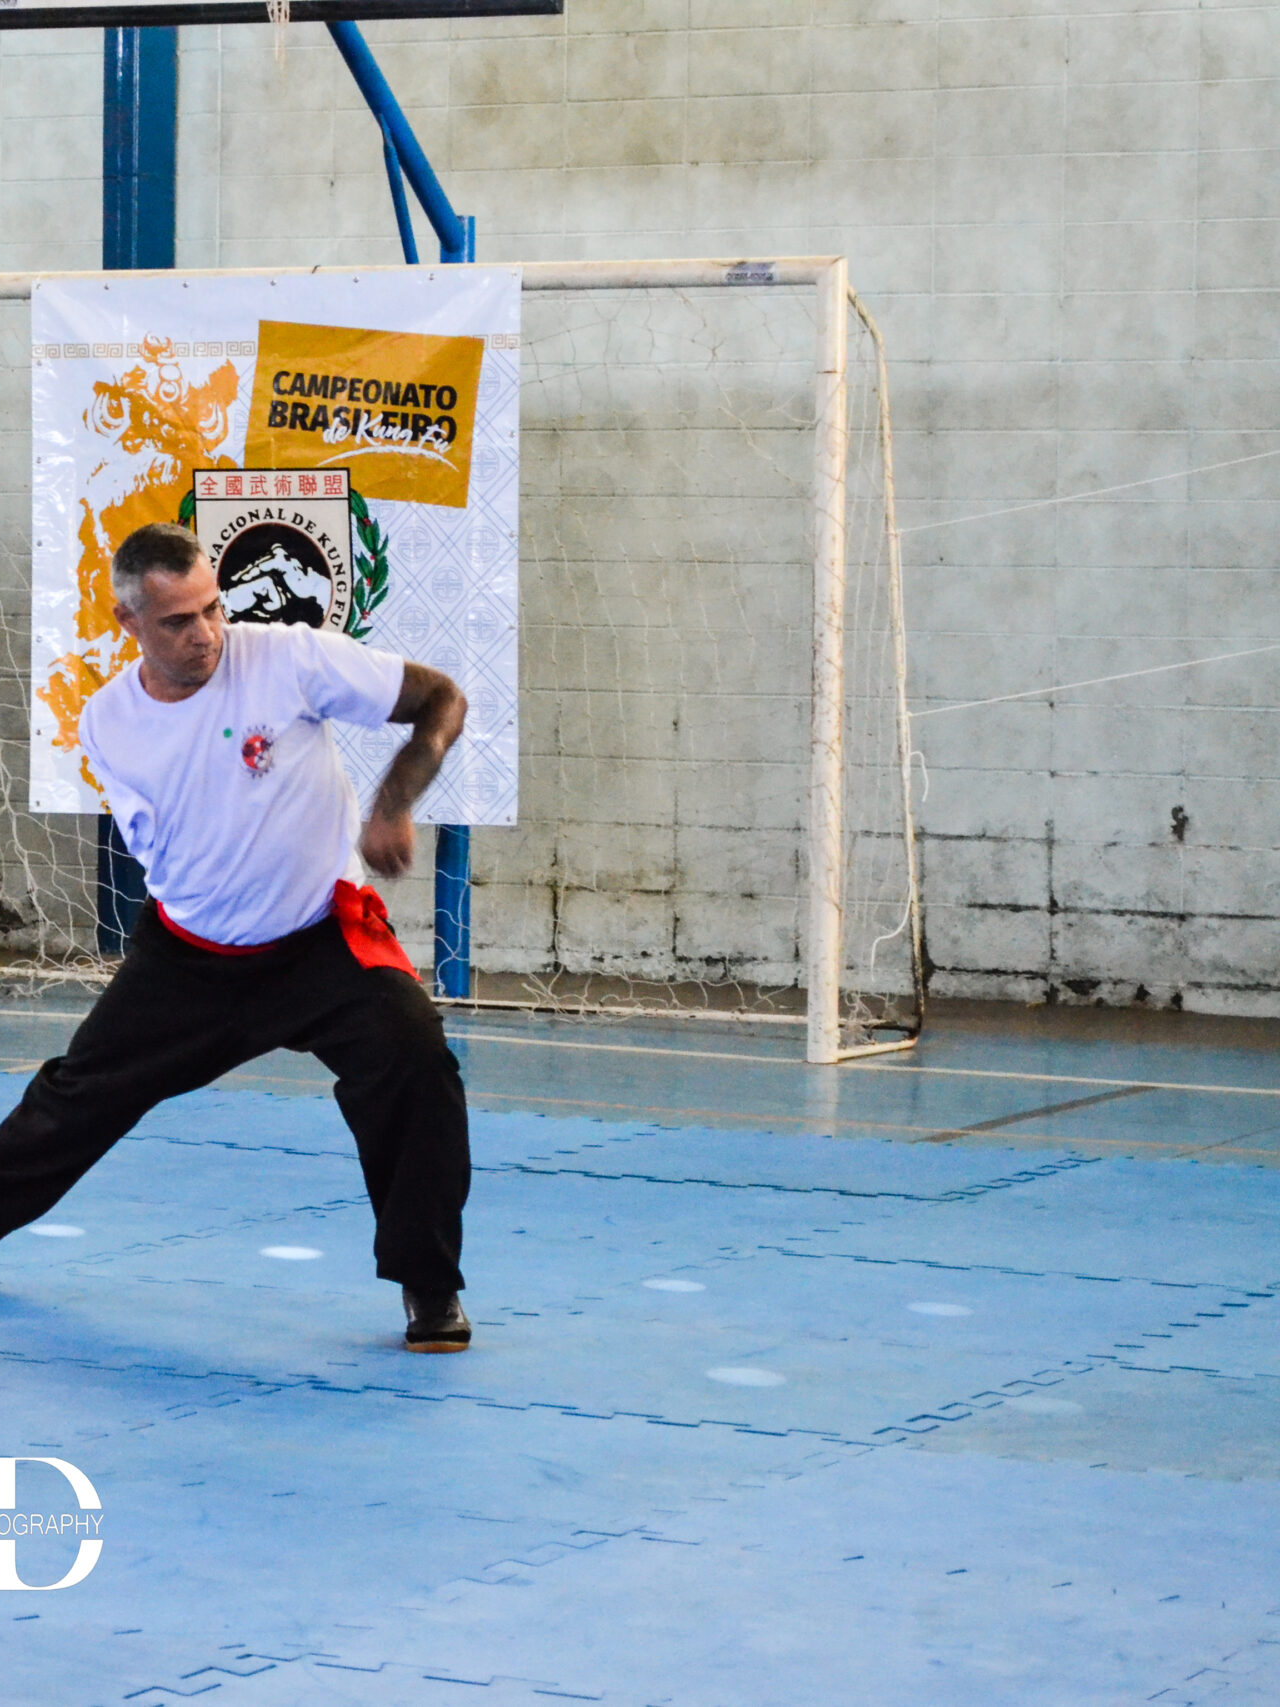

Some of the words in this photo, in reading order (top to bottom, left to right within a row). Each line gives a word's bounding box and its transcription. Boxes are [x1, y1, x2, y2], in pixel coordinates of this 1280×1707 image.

[272, 370, 458, 411] CAMPEONATO
[323, 415, 352, 445] de
[355, 413, 413, 448] Kung
[420, 424, 452, 454] Fu
[200, 474, 344, 496] 全國武術聯盟
[291, 512, 317, 534] DE
[317, 533, 348, 594] KUNG
[330, 599, 346, 627] FU
